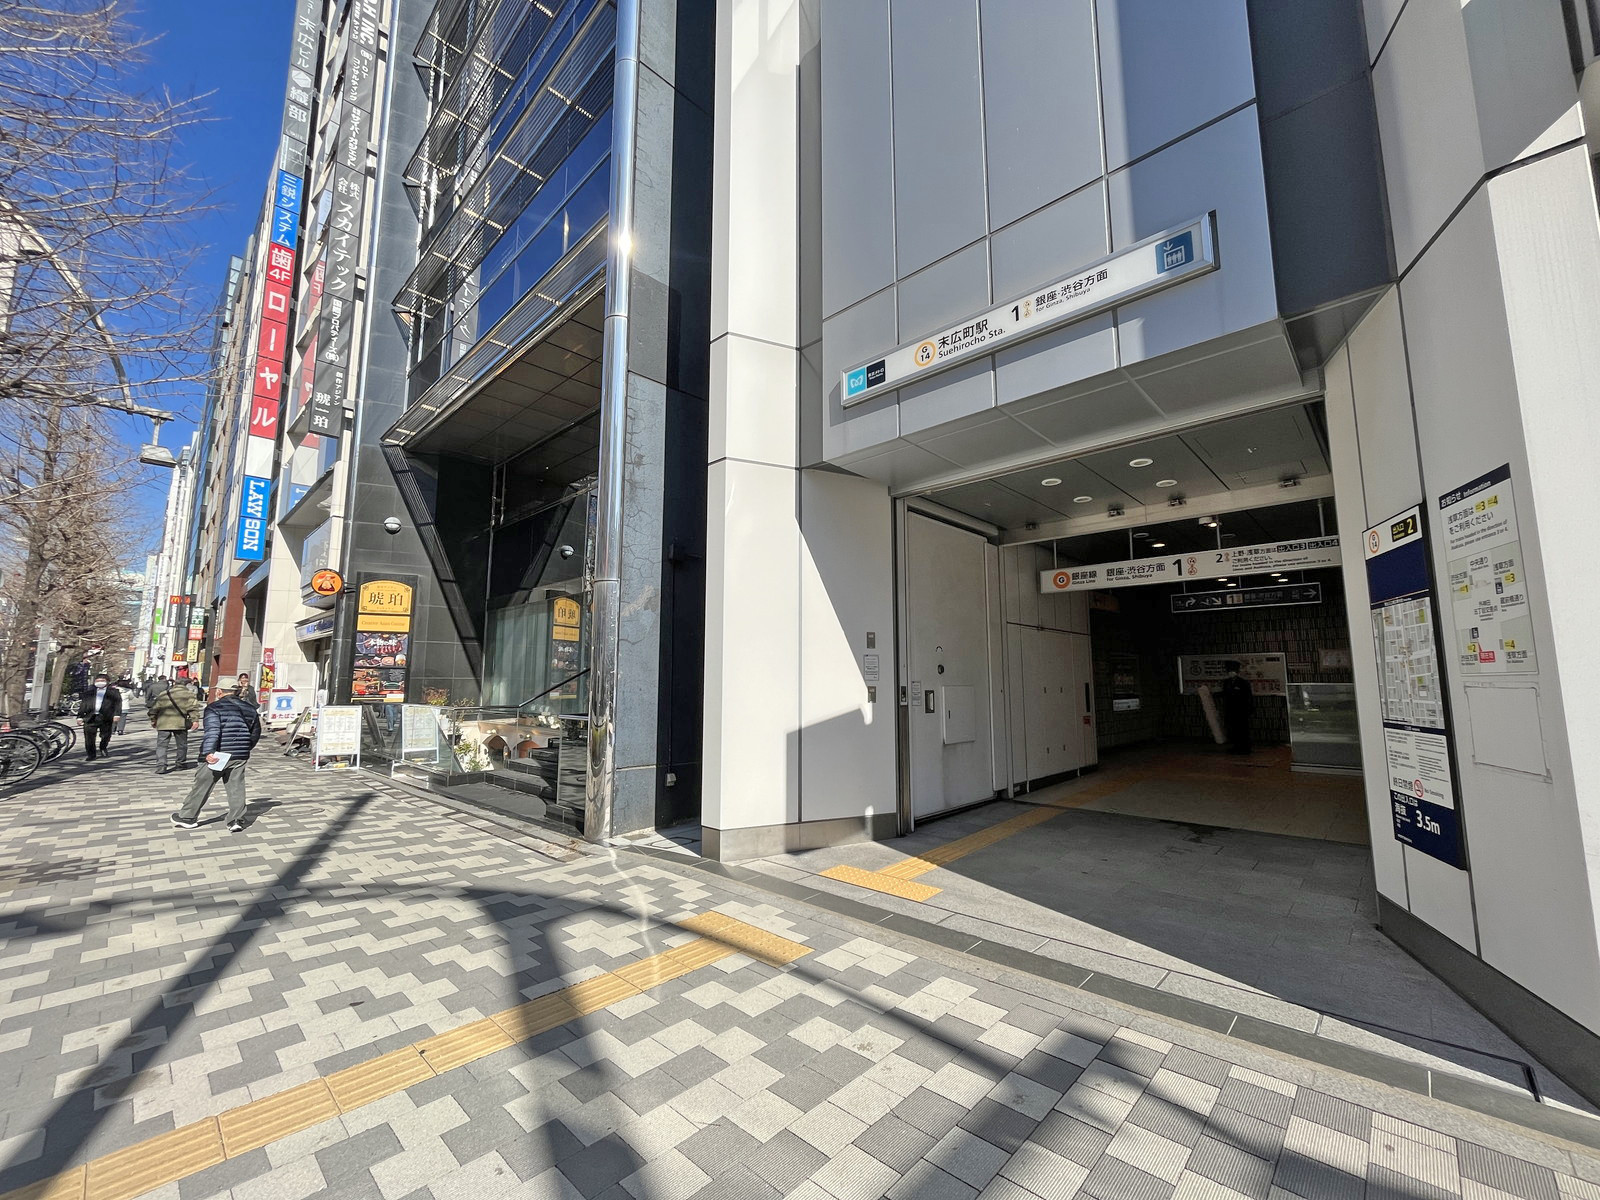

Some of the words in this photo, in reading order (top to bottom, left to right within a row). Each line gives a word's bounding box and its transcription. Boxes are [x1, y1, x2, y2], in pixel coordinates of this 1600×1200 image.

[360, 18, 375, 45] INC.
[288, 86, 309, 122] 織部
[277, 173, 297, 246] 三鋭システム
[330, 201, 354, 290] スカイテック
[272, 247, 292, 270] 歯
[269, 268, 290, 282] 4F
[1066, 287, 1091, 302] Shibuya
[1011, 305, 1020, 322] 1
[938, 318, 989, 349] 末広町駅
[921, 346, 928, 354] G
[938, 334, 986, 359] Suehirocho
[988, 327, 1006, 339] Sta.
[252, 291, 286, 428] ローヤル
[920, 352, 931, 361] 14
[1462, 480, 1492, 498] Information
[1441, 491, 1462, 508] お知らせ
[242, 479, 265, 551] LAWSON
[1406, 519, 1414, 534] 2
[1371, 541, 1378, 549] 14
[1215, 553, 1224, 564] 2
[1071, 569, 1098, 582] 銀座線
[1172, 558, 1183, 577] 1
[1058, 575, 1066, 585] G
[368, 591, 404, 606] 琥珀
[1415, 809, 1441, 836] 3.5m
